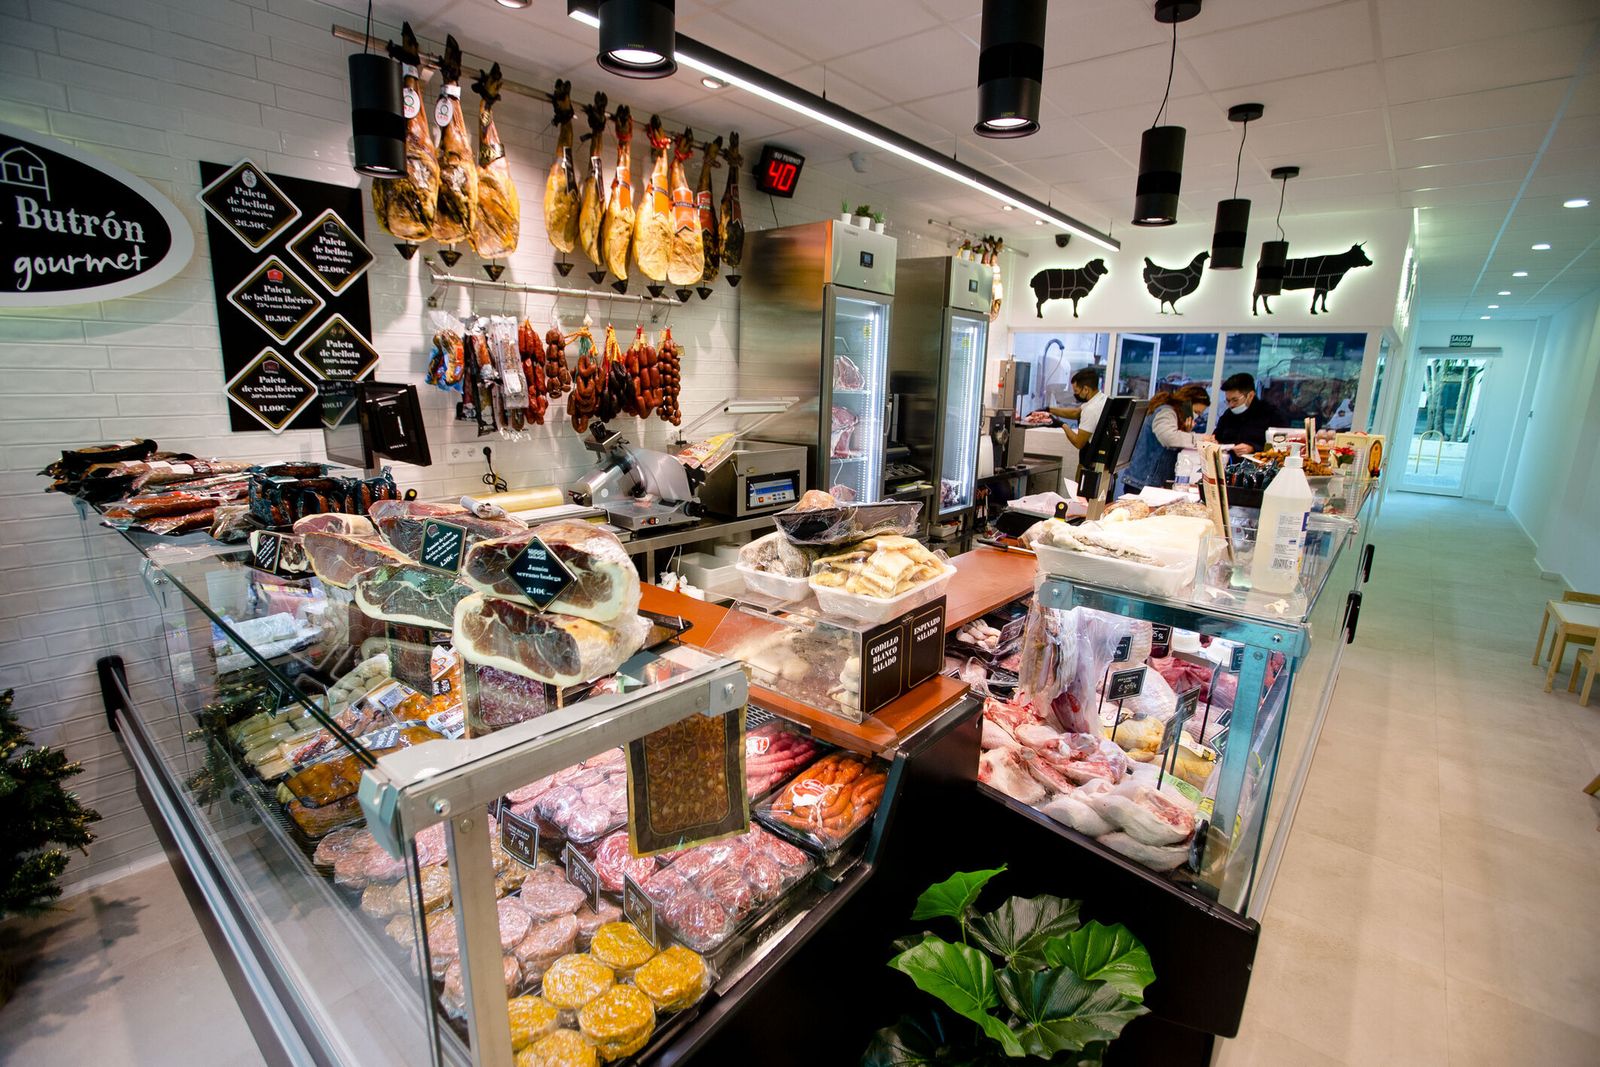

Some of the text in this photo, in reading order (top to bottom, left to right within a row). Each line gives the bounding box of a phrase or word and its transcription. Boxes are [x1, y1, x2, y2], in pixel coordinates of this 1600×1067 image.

[769, 160, 797, 191] 40
[235, 186, 267, 199] Paleta
[227, 196, 275, 211] de bellota
[16, 195, 146, 243] Butrón
[319, 236, 346, 247] Paleta
[312, 245, 353, 257] de bellota
[14, 245, 149, 291] gourmet
[264, 285, 291, 294] Paleta
[254, 293, 283, 302] bellota
[284, 295, 313, 304] ibérica
[326, 340, 353, 348] Paleta
[319, 349, 360, 358] de bellota
[528, 564, 548, 572] Jamón
[540, 573, 561, 582] bodega
[914, 616, 941, 635] ESPINAZO
[916, 626, 938, 642] SALADO
[870, 636, 899, 656] CODILLO
[872, 646, 898, 665] BLANCO
[872, 656, 897, 674] SALADO
